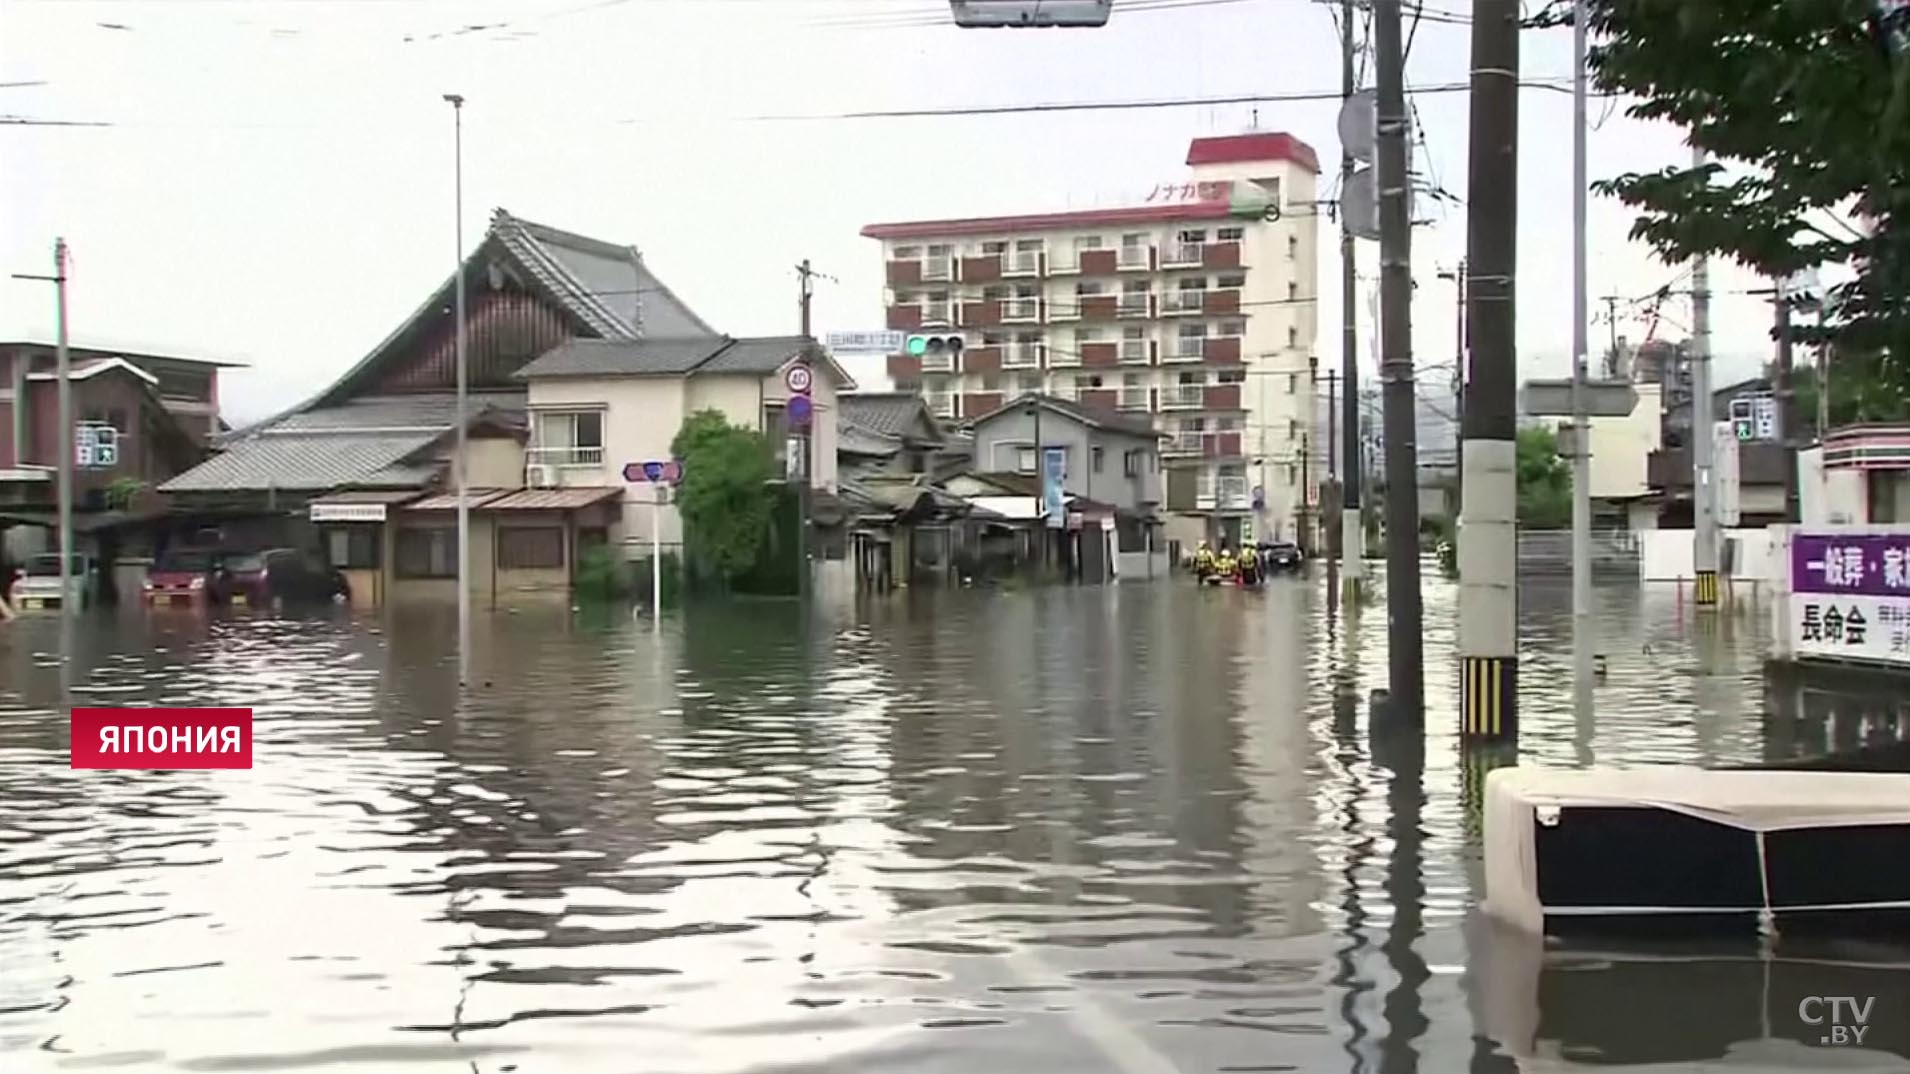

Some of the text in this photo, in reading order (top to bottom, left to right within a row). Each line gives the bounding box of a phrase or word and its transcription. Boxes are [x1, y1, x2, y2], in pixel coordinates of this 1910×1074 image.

[792, 373, 807, 385] 40
[1801, 604, 1867, 644] 長命会
